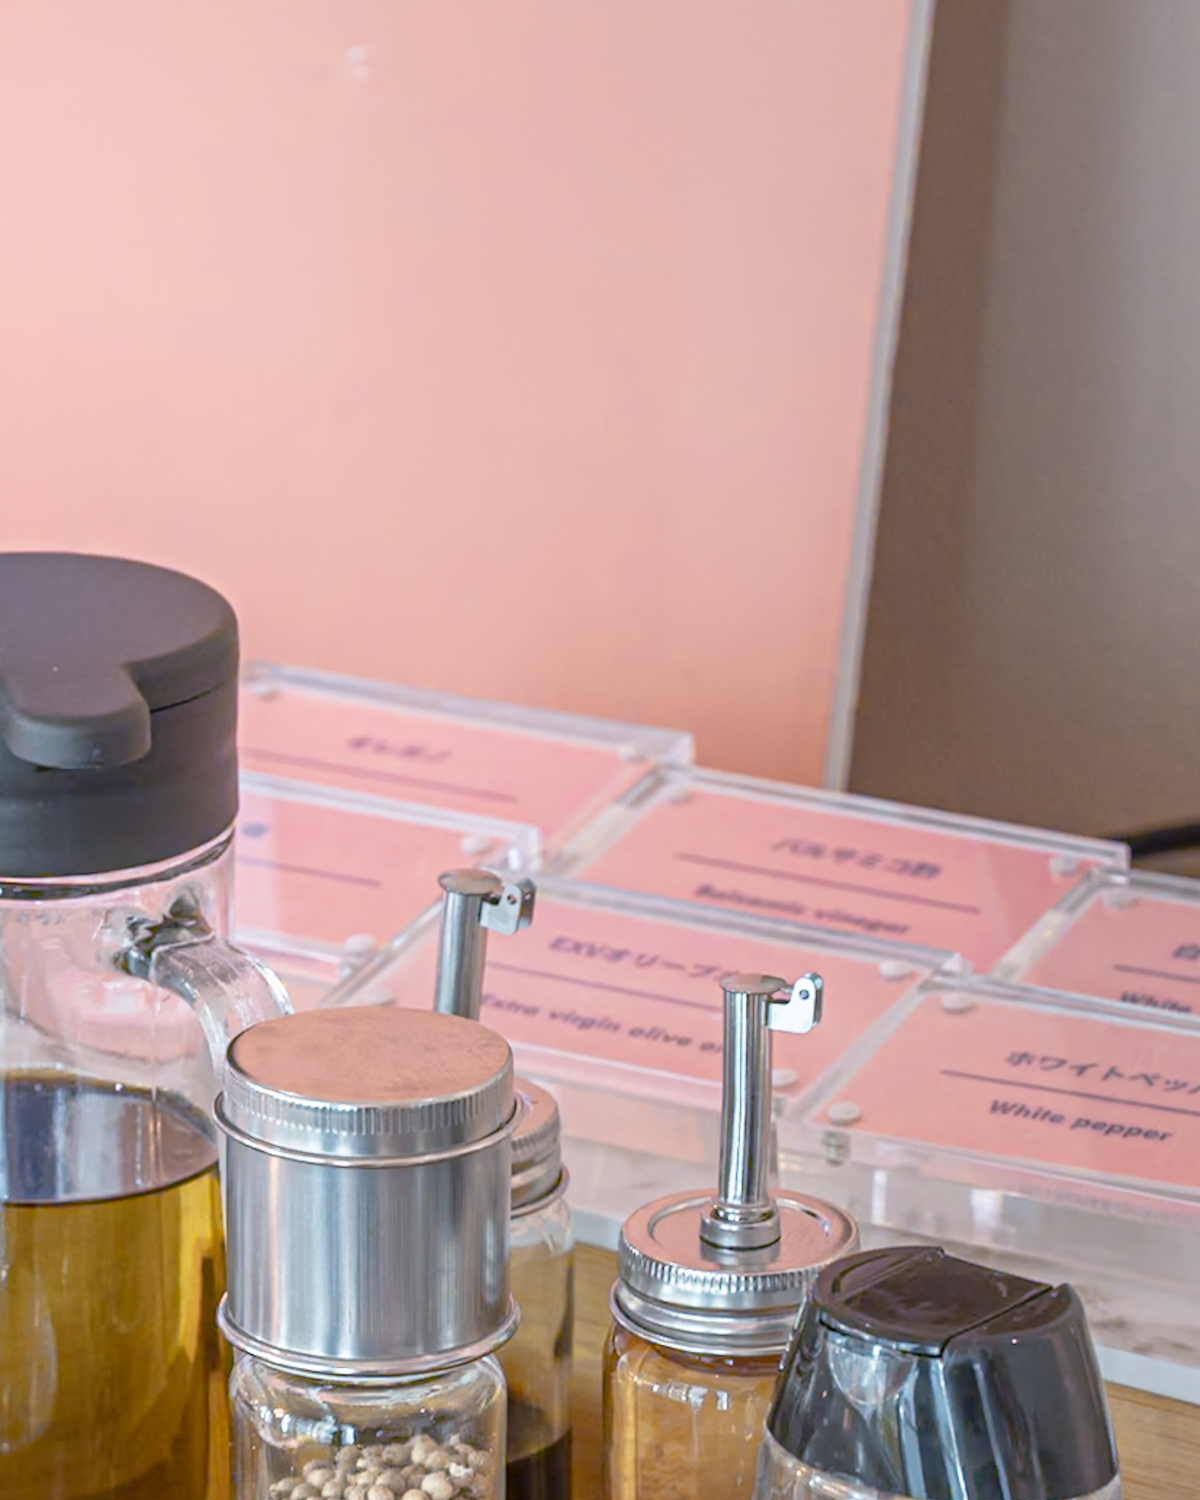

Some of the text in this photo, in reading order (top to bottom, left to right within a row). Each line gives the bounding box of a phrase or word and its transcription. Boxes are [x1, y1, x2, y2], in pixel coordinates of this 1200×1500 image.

[549, 1011, 621, 1034] virgin
[628, 1026, 693, 1047] olive
[989, 1099, 1173, 1142] White pepper
